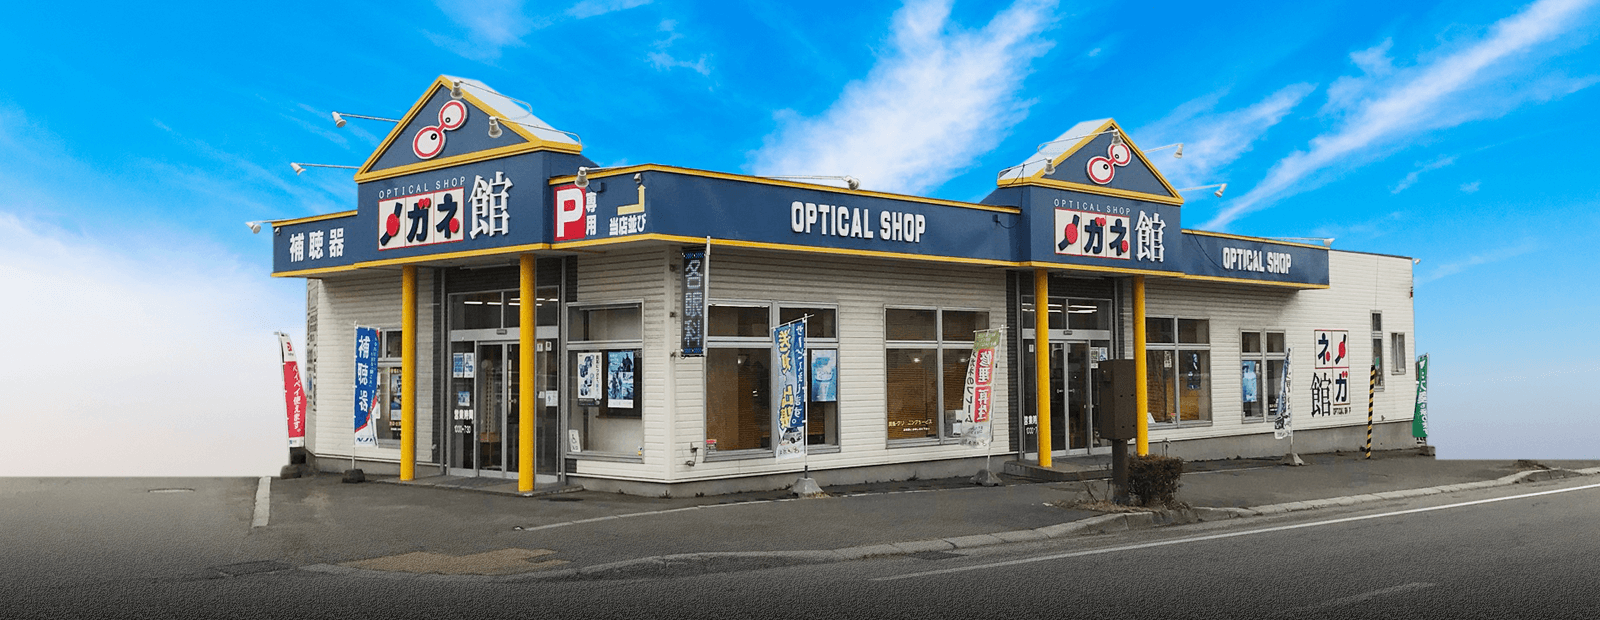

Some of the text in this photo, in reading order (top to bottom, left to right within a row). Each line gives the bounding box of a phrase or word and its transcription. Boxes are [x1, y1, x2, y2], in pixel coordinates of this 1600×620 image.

[378, 176, 467, 198] OPTICAL SHOP
[1053, 198, 1132, 216] OPTICAL SHOP
[556, 190, 584, 239] P
[585, 191, 598, 236] 専用
[608, 213, 648, 237] 当店並び
[790, 200, 927, 244] OPTICAL SHOP
[288, 227, 345, 263] 補聴器
[1222, 246, 1293, 275] OPTICAL SHOP
[684, 258, 703, 347] 各眼科
[357, 335, 371, 412] 補聴器
